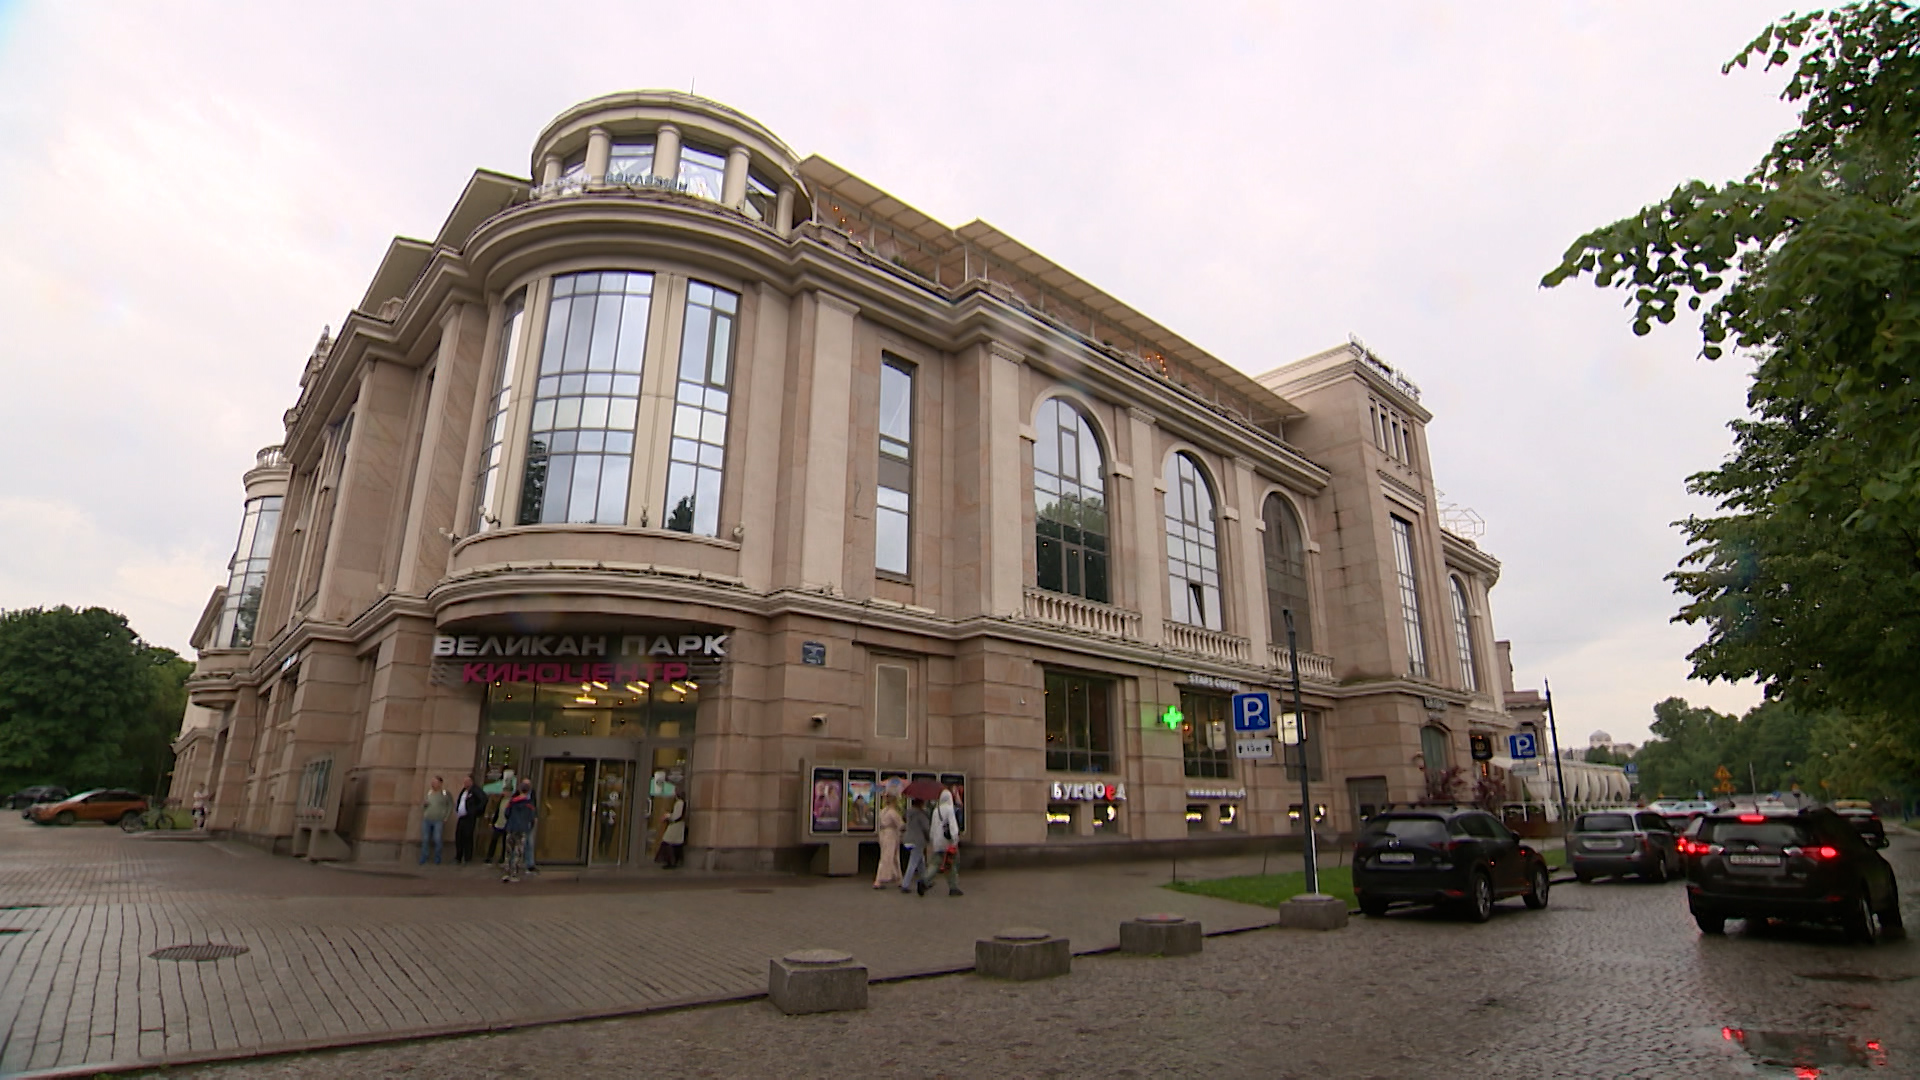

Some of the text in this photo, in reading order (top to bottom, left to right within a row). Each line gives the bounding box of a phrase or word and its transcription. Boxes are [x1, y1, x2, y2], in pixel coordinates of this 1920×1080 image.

[433, 634, 729, 656] ВЕЛИКАН ПАРК
[463, 663, 689, 683] КИНОЦЕНТР
[1242, 697, 1264, 727] P
[1515, 736, 1531, 756] P
